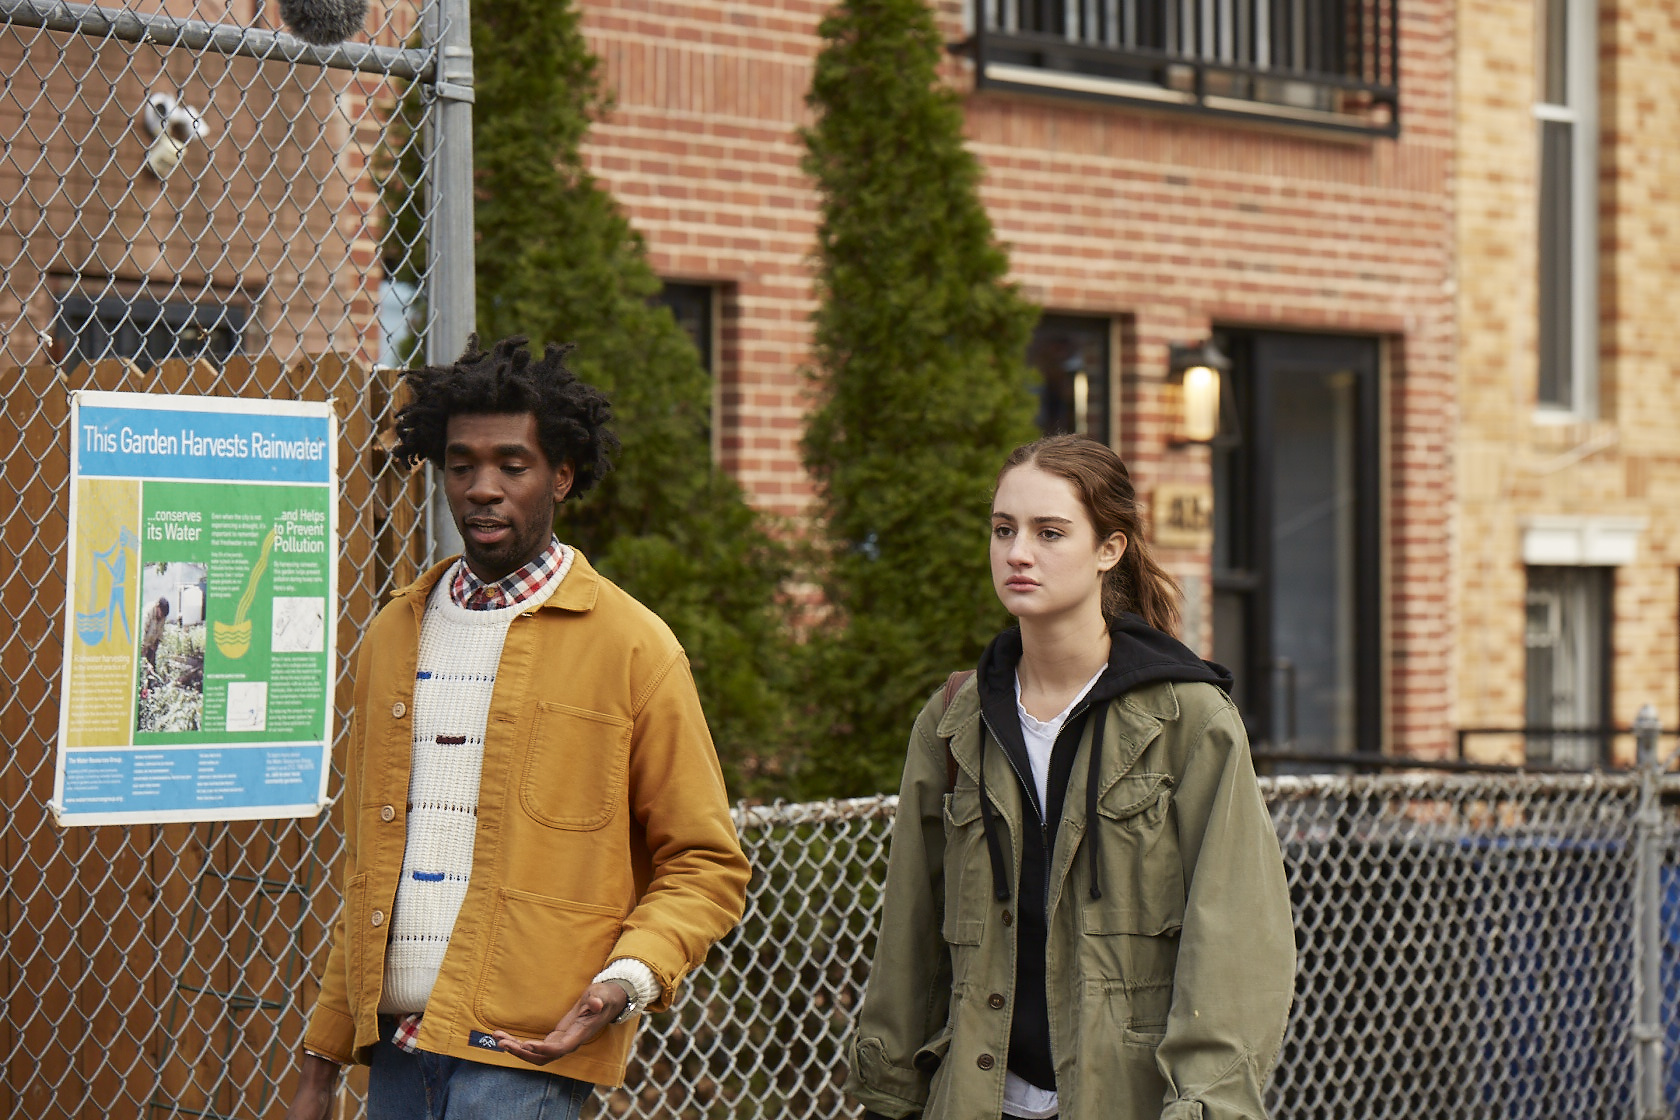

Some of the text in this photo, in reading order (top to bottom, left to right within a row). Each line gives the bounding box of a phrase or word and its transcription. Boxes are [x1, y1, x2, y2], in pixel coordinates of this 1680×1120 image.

[83, 425, 326, 461] This Garden Harvests Rainwater
[300, 509, 325, 524] Helps
[147, 522, 202, 541] its Water
[274, 521, 324, 536] to Prevent
[274, 536, 324, 553] Pollution
